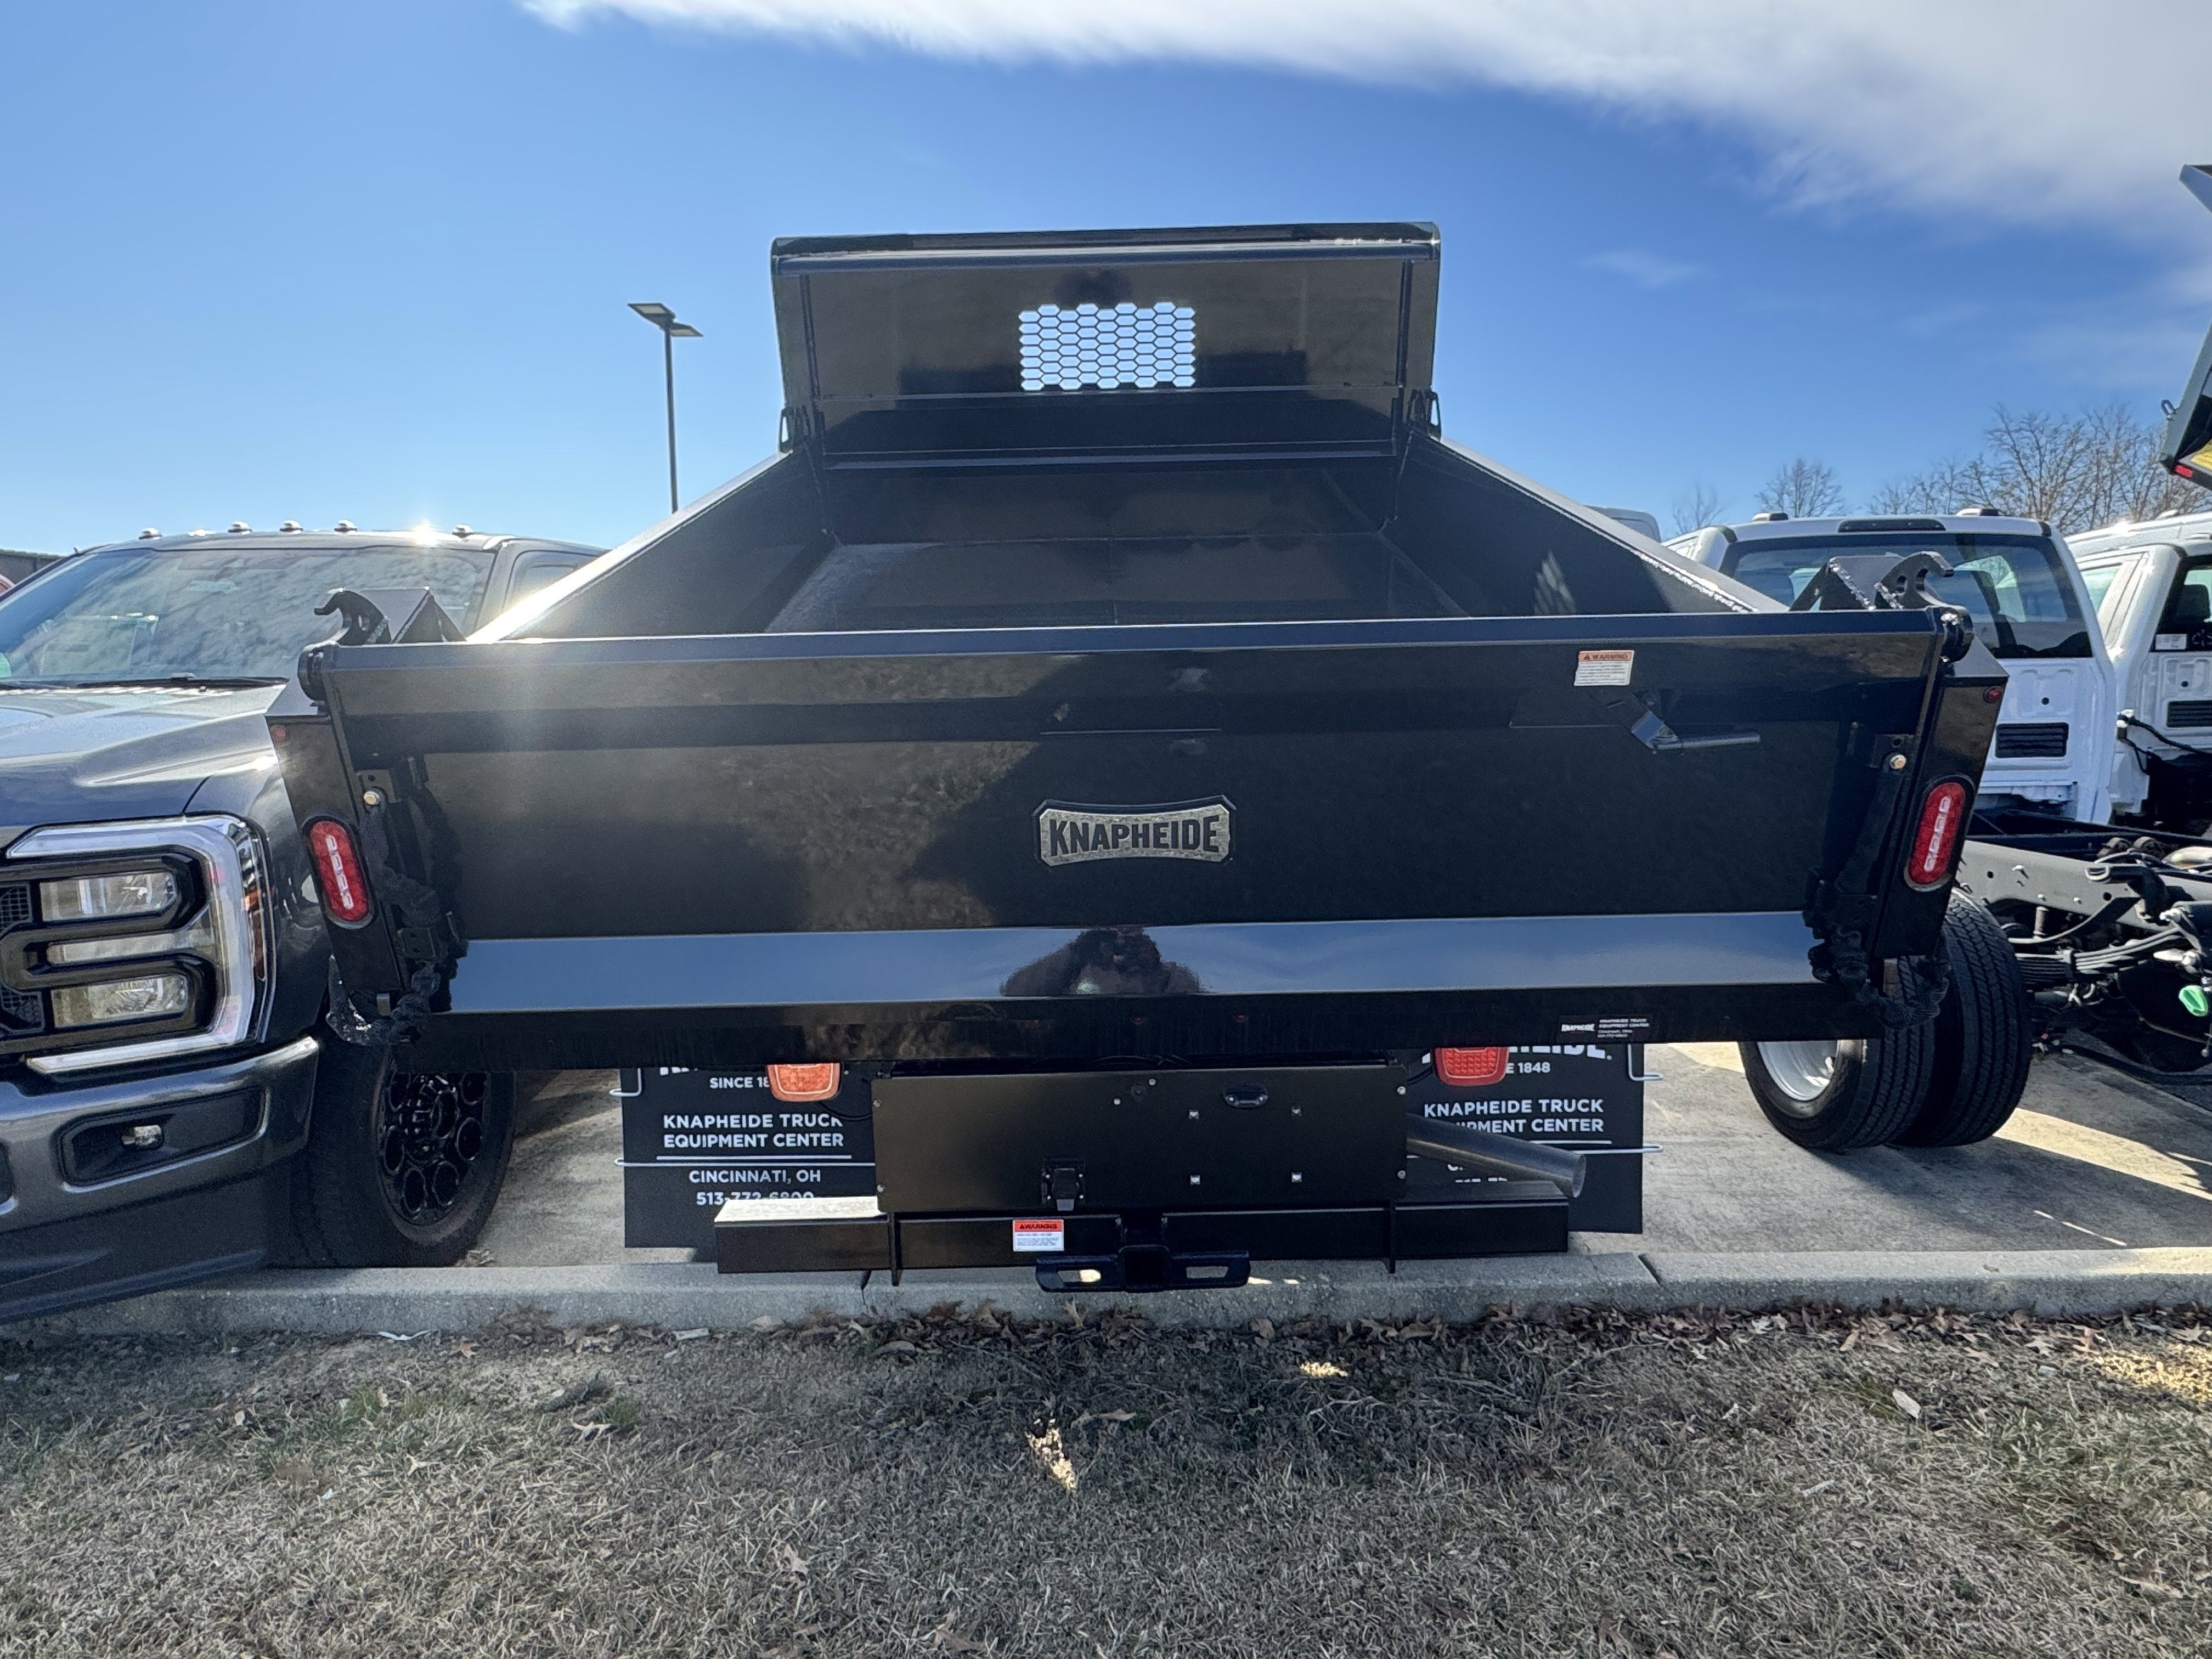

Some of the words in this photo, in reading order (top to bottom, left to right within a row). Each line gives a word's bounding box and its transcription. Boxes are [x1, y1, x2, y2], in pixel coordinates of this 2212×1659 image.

[1049, 815, 1220, 857] KNAPHEIDE
[1518, 1062, 1550, 1074] 1848
[710, 1077, 753, 1088] SINCE
[1425, 1099, 1532, 1118] KNAPHEIDE
[1538, 1099, 1604, 1113] TRUCK
[664, 1114, 774, 1128] KNAPHEIDE
[780, 1114, 843, 1127] TRUCK
[1531, 1118, 1604, 1132] CENTER
[664, 1134, 768, 1148] EQUIPMENT
[773, 1133, 844, 1147] CENTER
[689, 1170, 791, 1184] CINCINNATI,
[796, 1170, 821, 1183] OH
